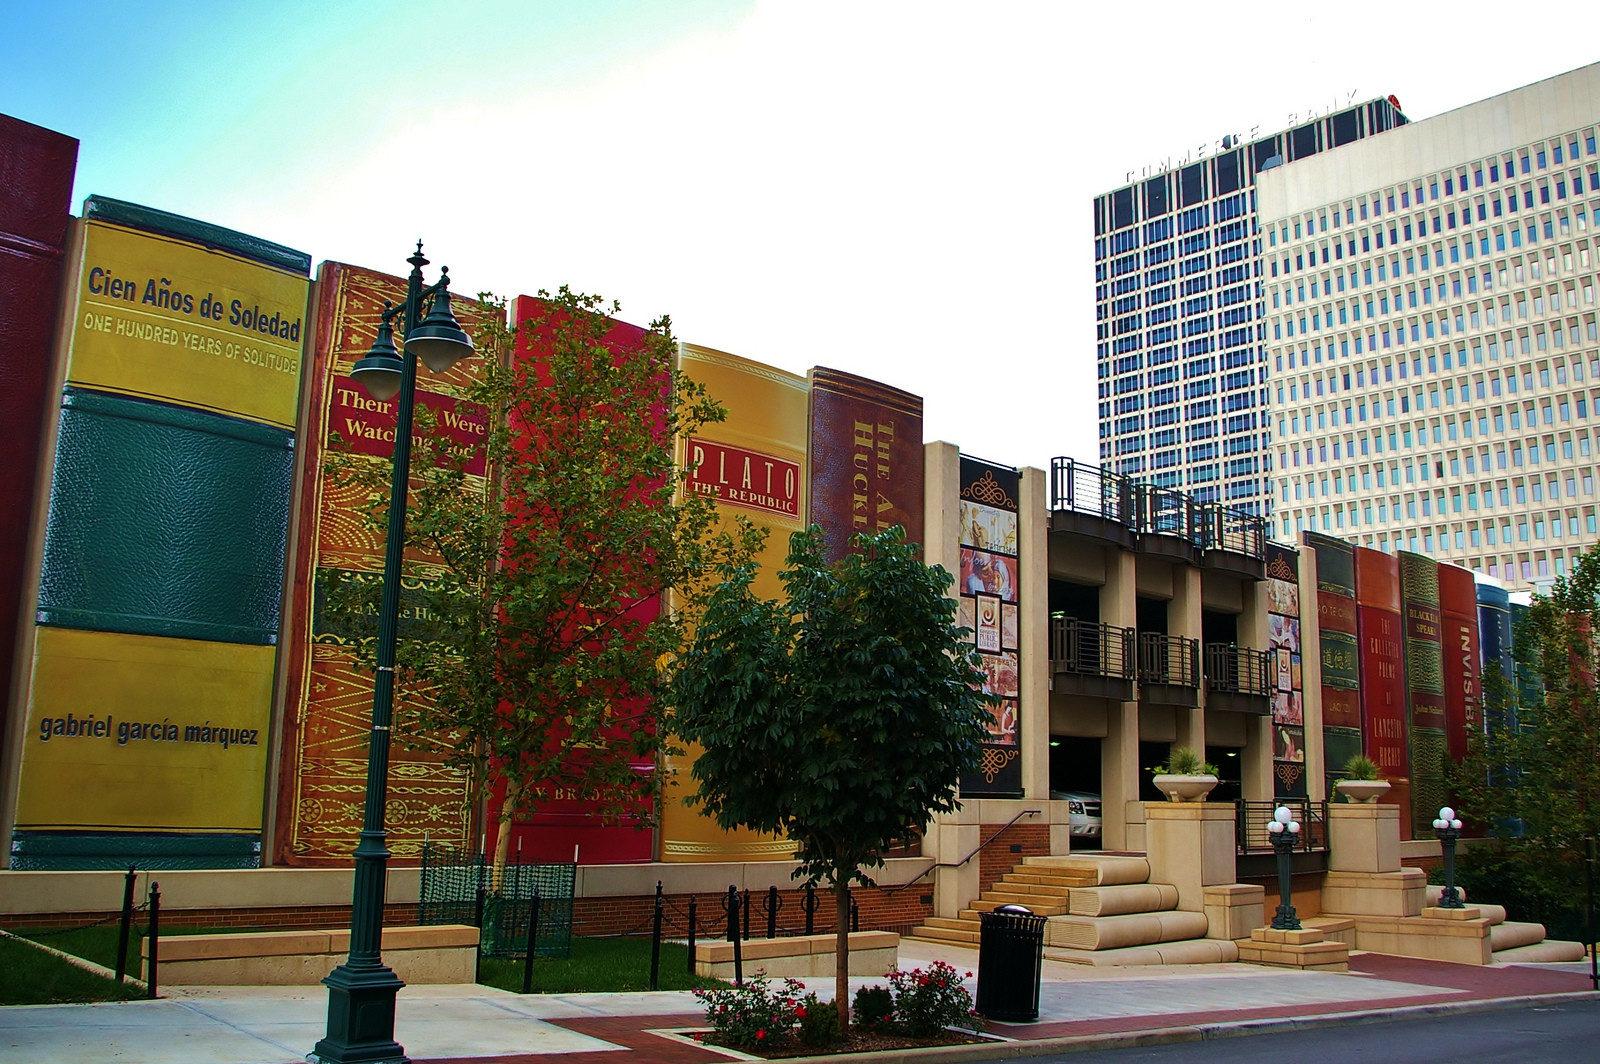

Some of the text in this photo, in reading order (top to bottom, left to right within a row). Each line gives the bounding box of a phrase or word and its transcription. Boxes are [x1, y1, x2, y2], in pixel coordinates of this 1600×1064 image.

[88, 266, 301, 343] Cien Años de Soledad
[84, 312, 297, 376] ONE HUNDRED YEARS OF SOLITUDE
[337, 388, 485, 436] Their Were
[693, 445, 794, 499] PLATO
[877, 420, 894, 481] THE
[692, 481, 793, 512] THE REPUBLIC
[39, 713, 259, 750] gabriel garcía márquez
